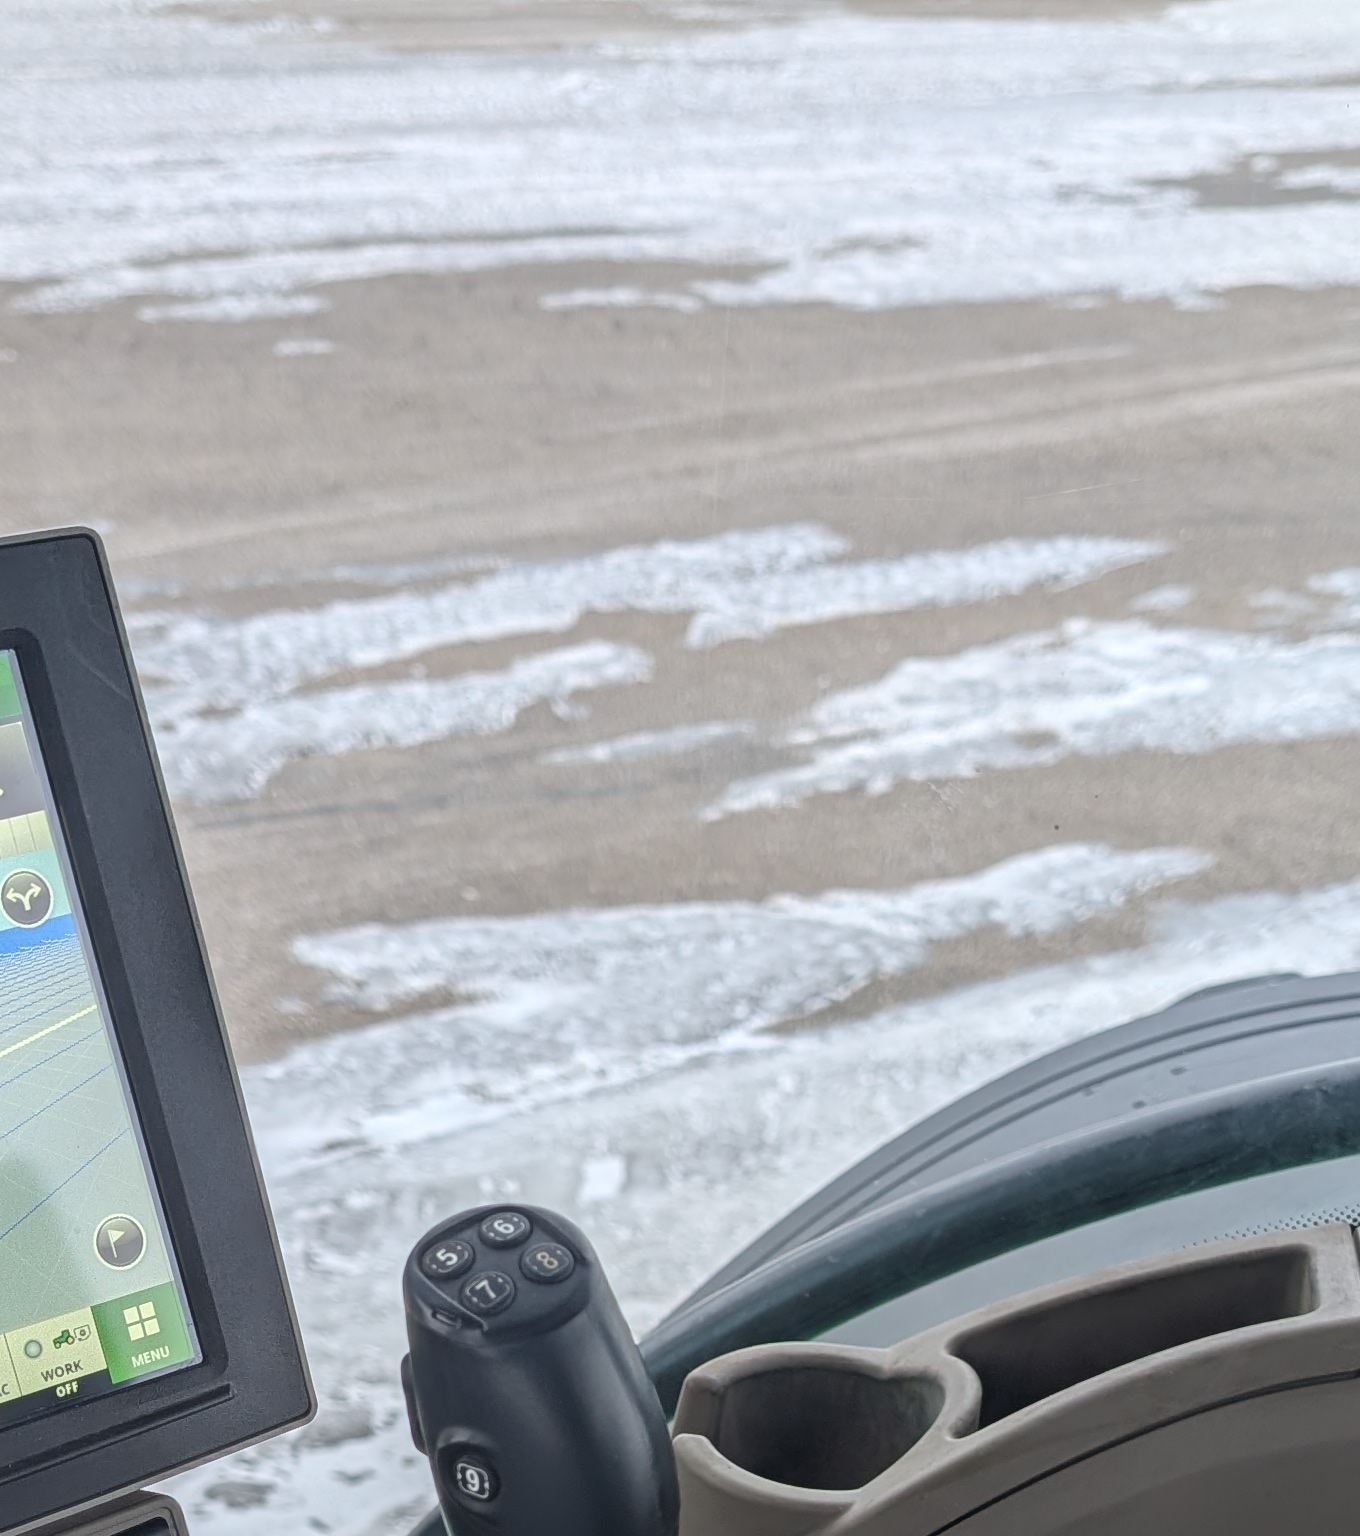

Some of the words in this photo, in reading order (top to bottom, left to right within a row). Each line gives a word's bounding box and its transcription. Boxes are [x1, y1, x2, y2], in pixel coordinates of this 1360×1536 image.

[493, 1218, 515, 1235] 6
[437, 1247, 458, 1267] 5
[536, 1251, 559, 1270] 8
[474, 1279, 496, 1301] 7
[130, 1345, 170, 1369] MENU
[40, 1359, 84, 1382] WORK
[55, 1379, 80, 1398] OFF
[465, 1468, 480, 1492] 9
